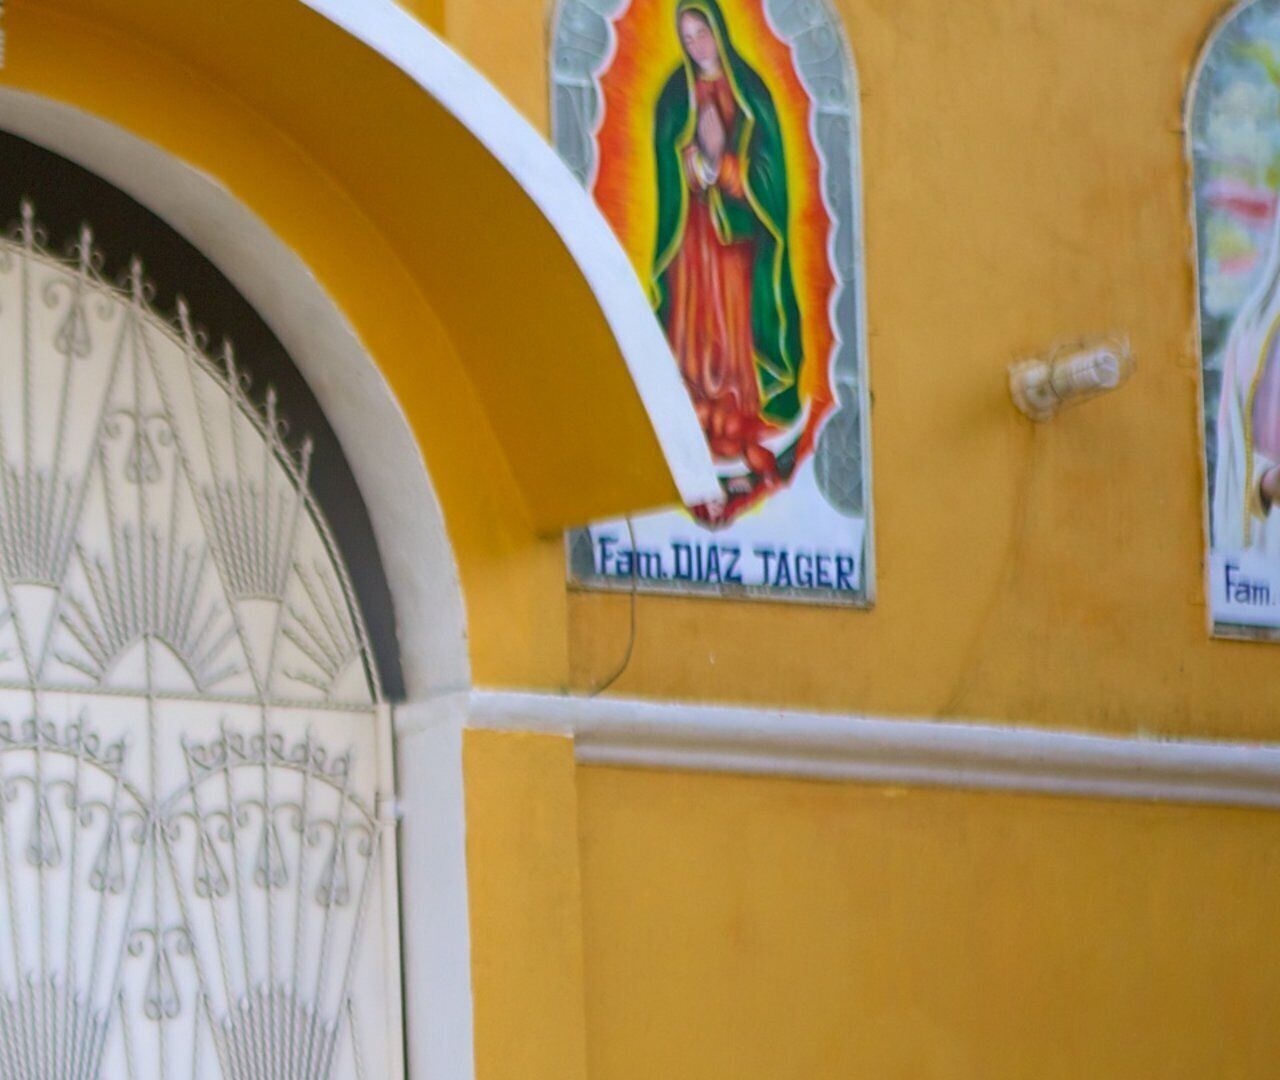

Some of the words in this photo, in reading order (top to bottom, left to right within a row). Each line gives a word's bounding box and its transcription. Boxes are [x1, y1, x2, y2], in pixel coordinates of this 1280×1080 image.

[598, 536, 668, 579] Fam.
[671, 543, 743, 584] DIAZ
[753, 549, 855, 590] TAGER
[1224, 563, 1277, 606] Fam.
